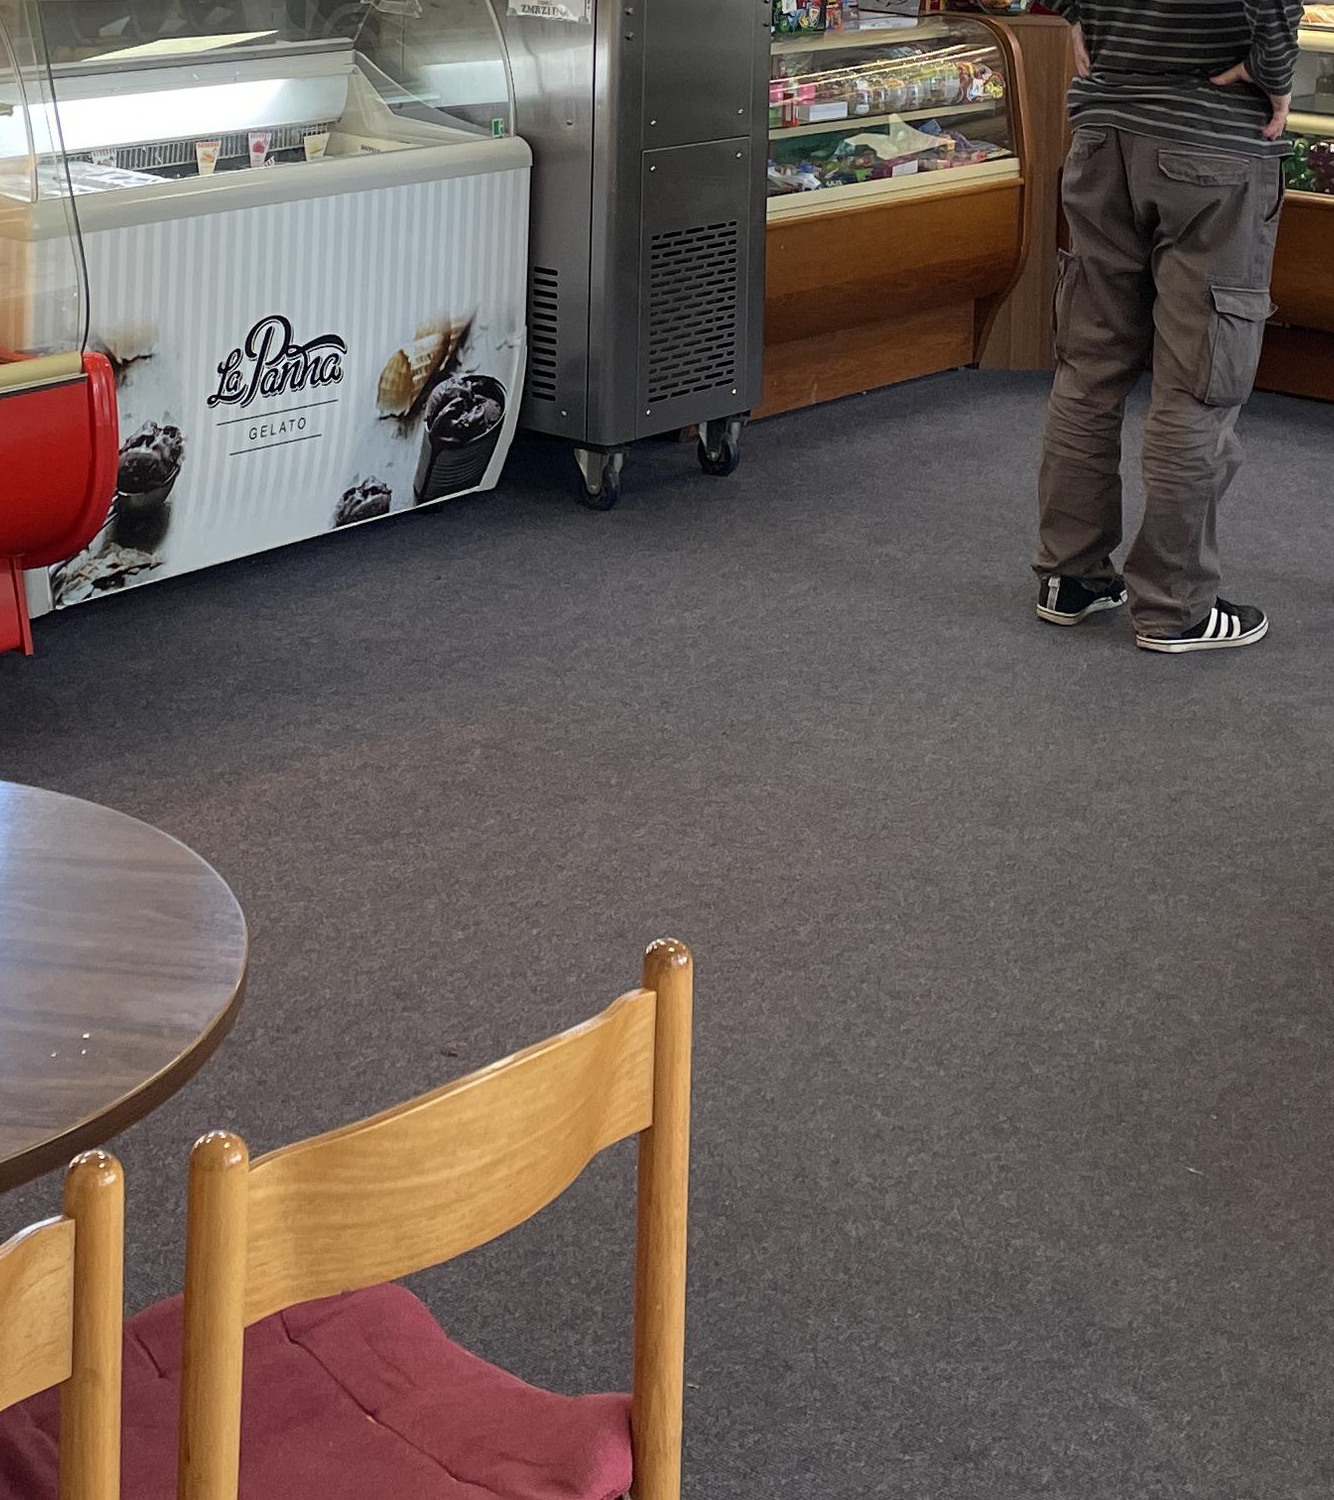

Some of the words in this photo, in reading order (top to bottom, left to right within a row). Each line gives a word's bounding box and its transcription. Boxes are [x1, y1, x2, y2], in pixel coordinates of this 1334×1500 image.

[207, 348, 247, 408] La
[243, 315, 348, 407] Panna
[249, 417, 308, 441] GELATO
